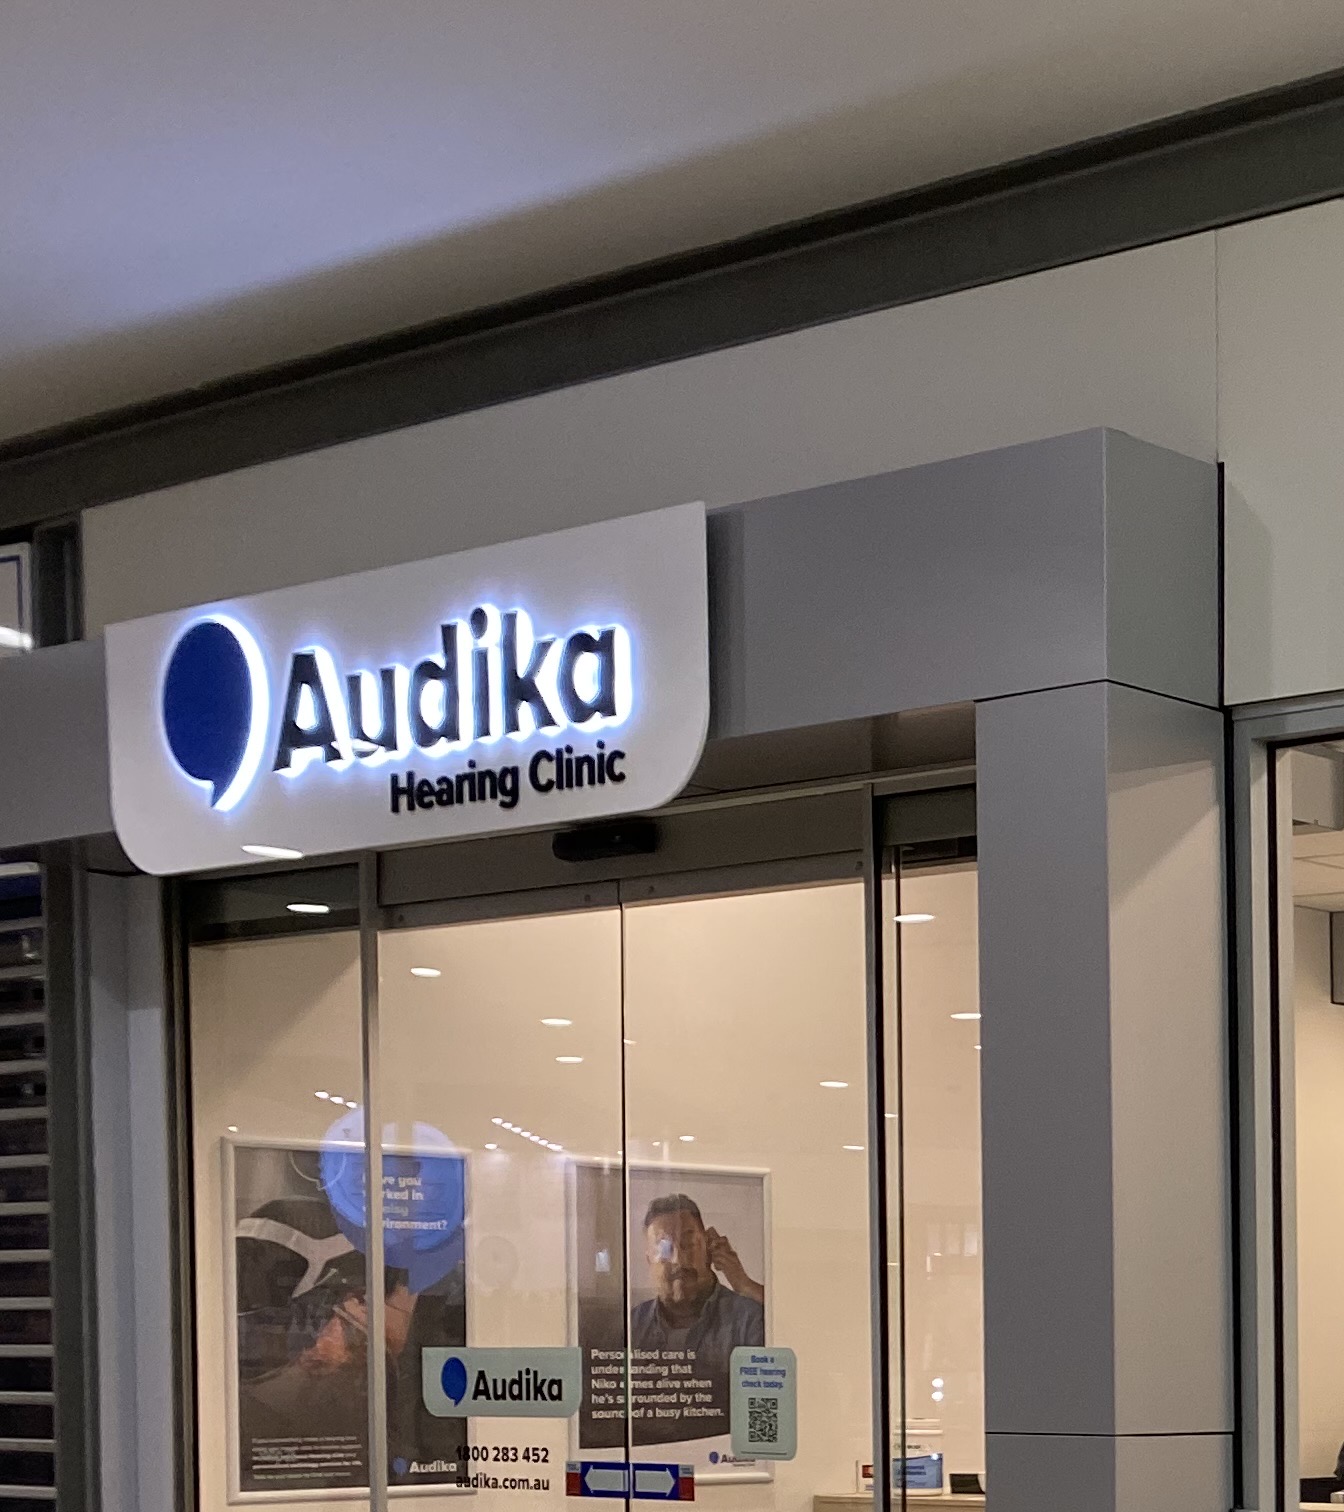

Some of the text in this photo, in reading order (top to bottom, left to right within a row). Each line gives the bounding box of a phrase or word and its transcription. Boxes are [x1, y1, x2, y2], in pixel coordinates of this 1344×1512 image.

[274, 603, 618, 772] Audika
[390, 741, 626, 813] Hearing Clinic
[661, 1351, 685, 1360] care
[671, 1364, 692, 1374] that
[472, 1368, 563, 1401] Audika
[456, 1446, 549, 1463] 1800 283 452
[408, 1459, 458, 1474] Audika
[456, 1472, 550, 1490] audika.com.au
